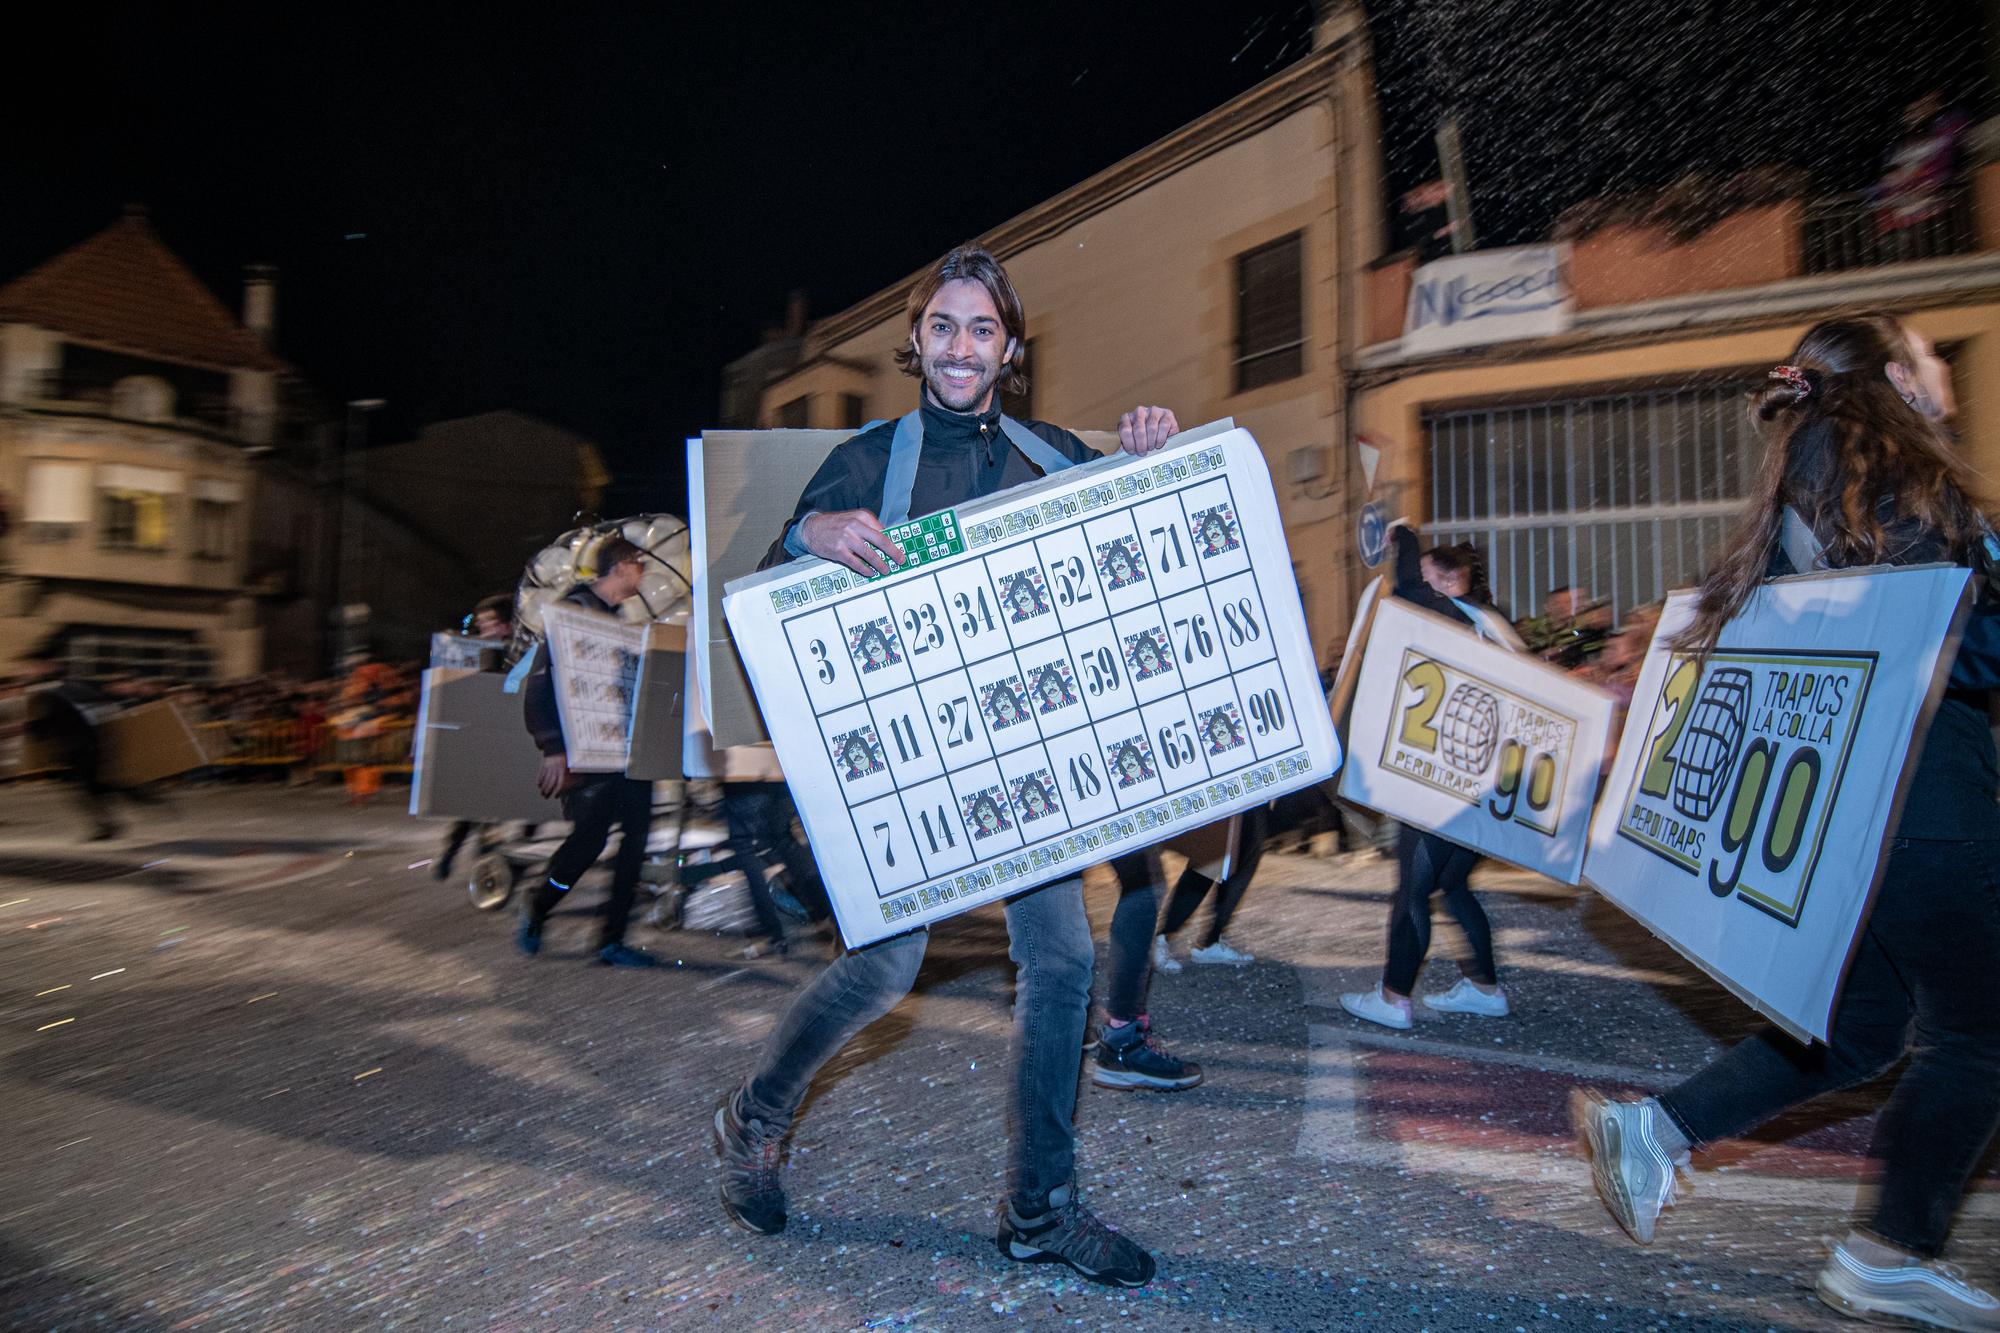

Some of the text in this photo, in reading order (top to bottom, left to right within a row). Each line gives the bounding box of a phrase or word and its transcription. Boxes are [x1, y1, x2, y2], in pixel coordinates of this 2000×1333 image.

[1191, 502, 1228, 521] PEACE AND LOVE
[1095, 533, 1134, 552] PEACE AND LOVE
[1150, 524, 1188, 573] 71
[1202, 541, 1240, 559] BINGO STARR
[998, 566, 1037, 585] PEACE AND LOVE
[1051, 556, 1092, 607] 52
[1107, 573, 1146, 591] BINGO STARR
[954, 586, 996, 638] 34
[1011, 604, 1050, 624] BINGO STARR
[848, 615, 888, 635] PEACE AND LOVE
[903, 604, 944, 655] 23
[1223, 598, 1260, 647] 88
[1123, 625, 1161, 644] PEACE AND LOVE
[1174, 614, 1213, 664] 76
[810, 639, 835, 685] 3
[862, 654, 902, 674] BINGO STARR
[1027, 657, 1065, 678] PEACE AND LOVE
[1081, 647, 1119, 696] 59
[1135, 663, 1173, 682] BINGO STARR
[979, 674, 1018, 694] PEACE AND LOVE
[1763, 671, 1849, 716] TRAPICS
[1039, 696, 1077, 715] BINGO STARR
[1197, 701, 1234, 720] PEACE AND LOVE
[1249, 688, 1284, 736] 90
[938, 696, 973, 748] 27
[992, 712, 1030, 731] BINGO STARR
[1509, 703, 1564, 743] TRAPICS
[1752, 707, 1833, 745] LA COLLA
[831, 724, 872, 744] PEACE AND LOVE
[888, 714, 924, 764] 11
[1106, 733, 1144, 753] PEACE AND LOVE
[1159, 719, 1195, 769] 65
[1209, 737, 1246, 757] BINGO STARR
[845, 763, 885, 782] BINGO STARR
[1009, 767, 1047, 787] PEACE AND LOVE
[1070, 753, 1101, 801] 48
[1118, 770, 1155, 789] BINGO STARR
[1393, 751, 1482, 798] PERDITRAPS
[961, 784, 1000, 804] PEACE AND LOVE
[1021, 804, 1060, 824] BINGO STARR
[919, 805, 957, 855] 14
[974, 821, 1013, 840] BINGO STARR
[1629, 804, 1706, 859] PERDITRAPS
[873, 822, 895, 867] 7
